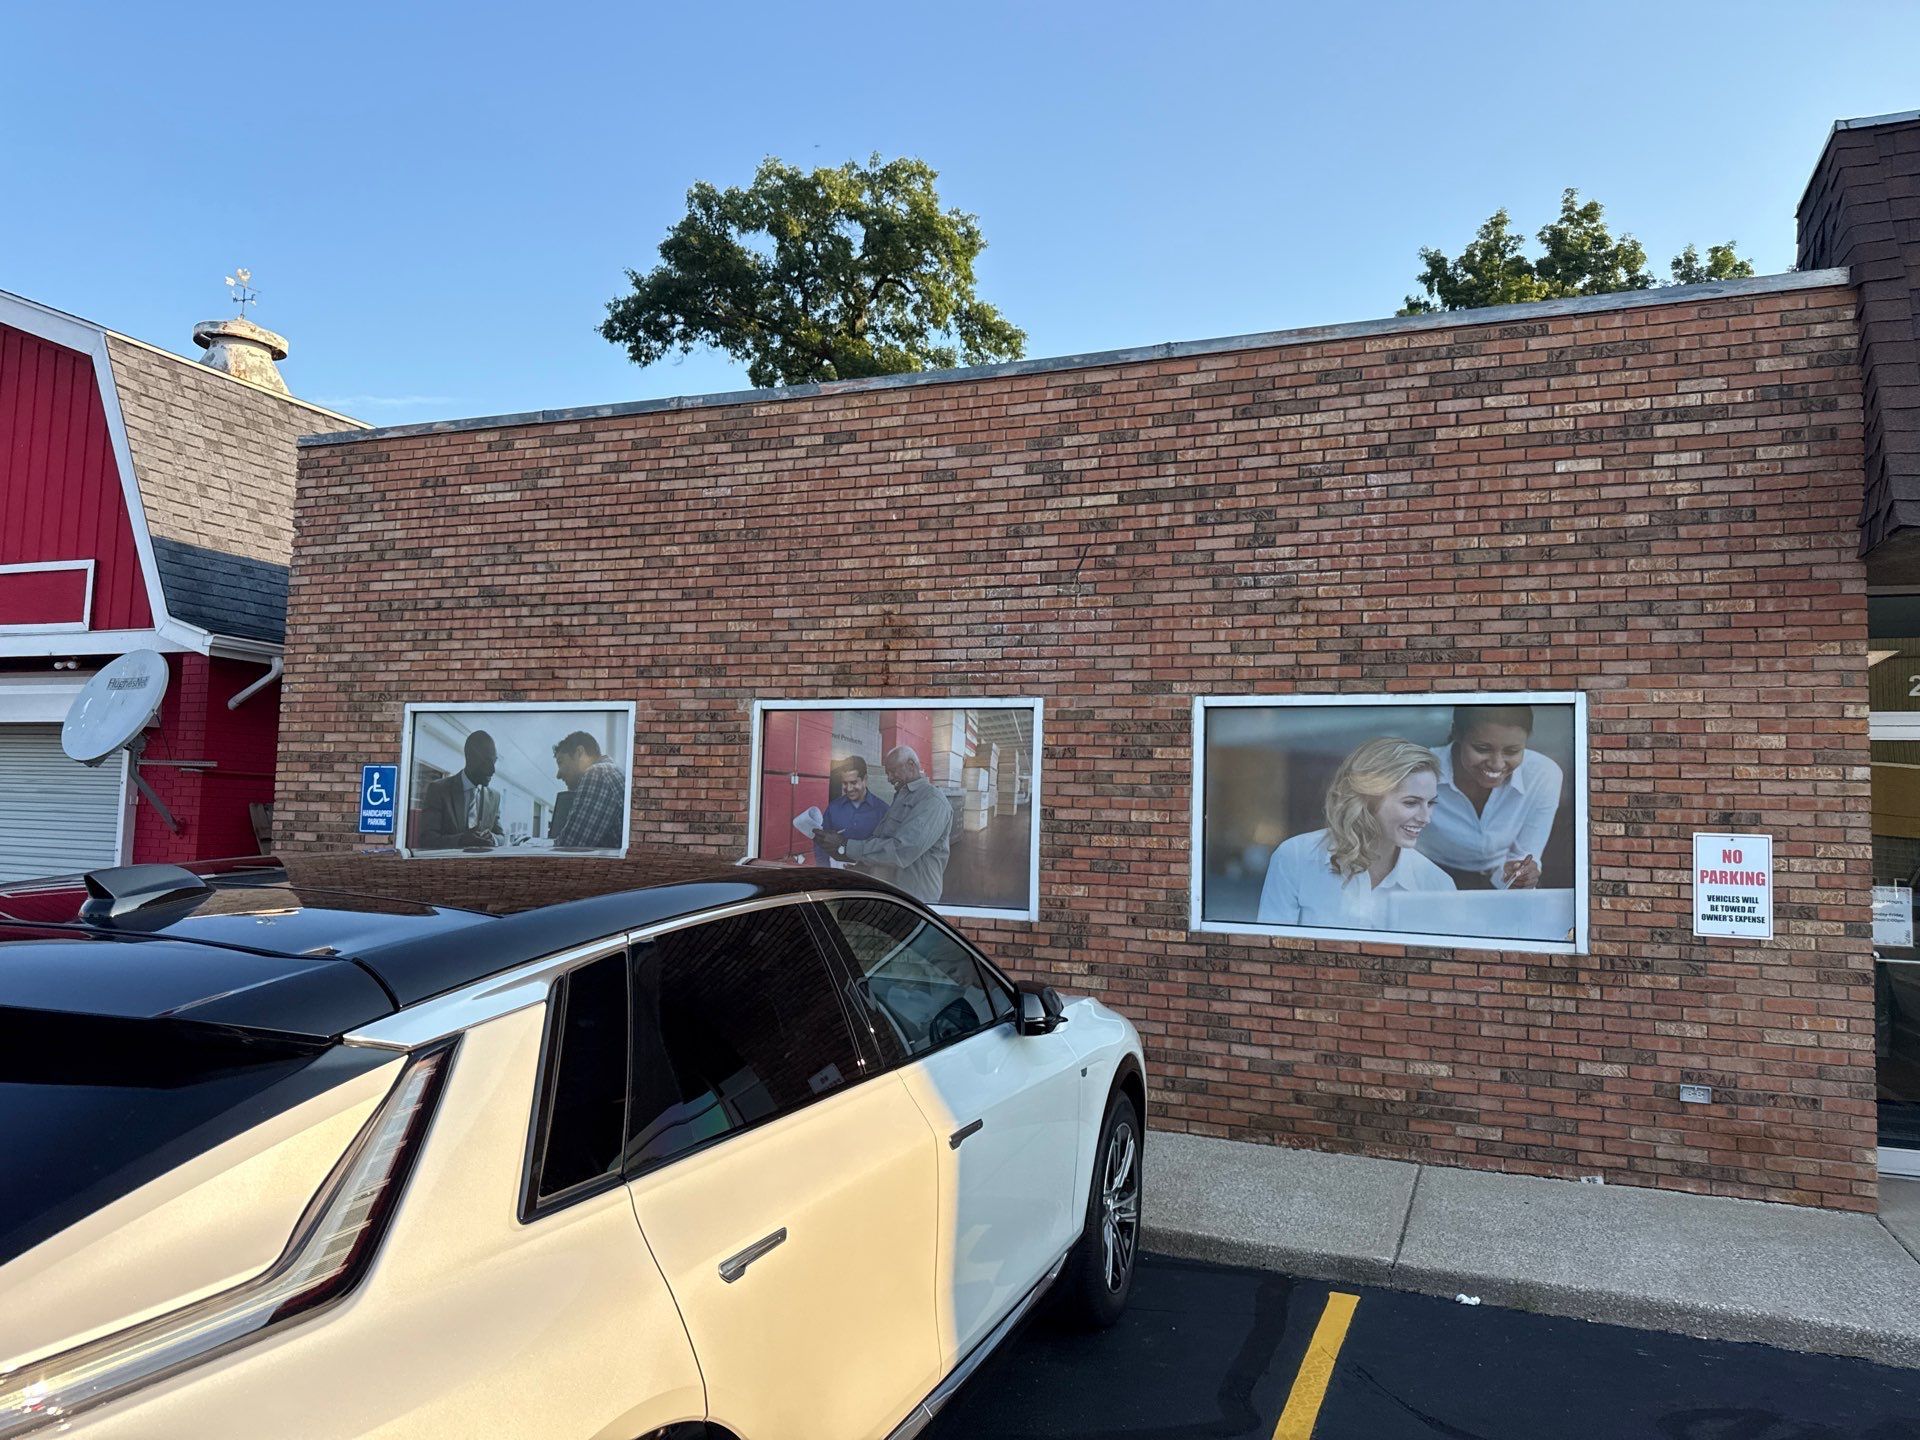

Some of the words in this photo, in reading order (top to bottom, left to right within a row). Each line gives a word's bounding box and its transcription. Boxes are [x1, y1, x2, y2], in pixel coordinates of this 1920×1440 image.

[362, 809, 393, 818] HANDICAPPED
[367, 817, 386, 826] PARKING
[1722, 849, 1743, 864] NO
[1700, 870, 1766, 886] PARKING
[1706, 894, 1740, 904] VEHICLES
[1741, 896, 1759, 904] WILL
[1710, 904, 1719, 912] BE
[1720, 905, 1746, 913] TOWED
[1701, 914, 1733, 922] OWNER'S
[1734, 915, 1765, 924] EXPENSE
